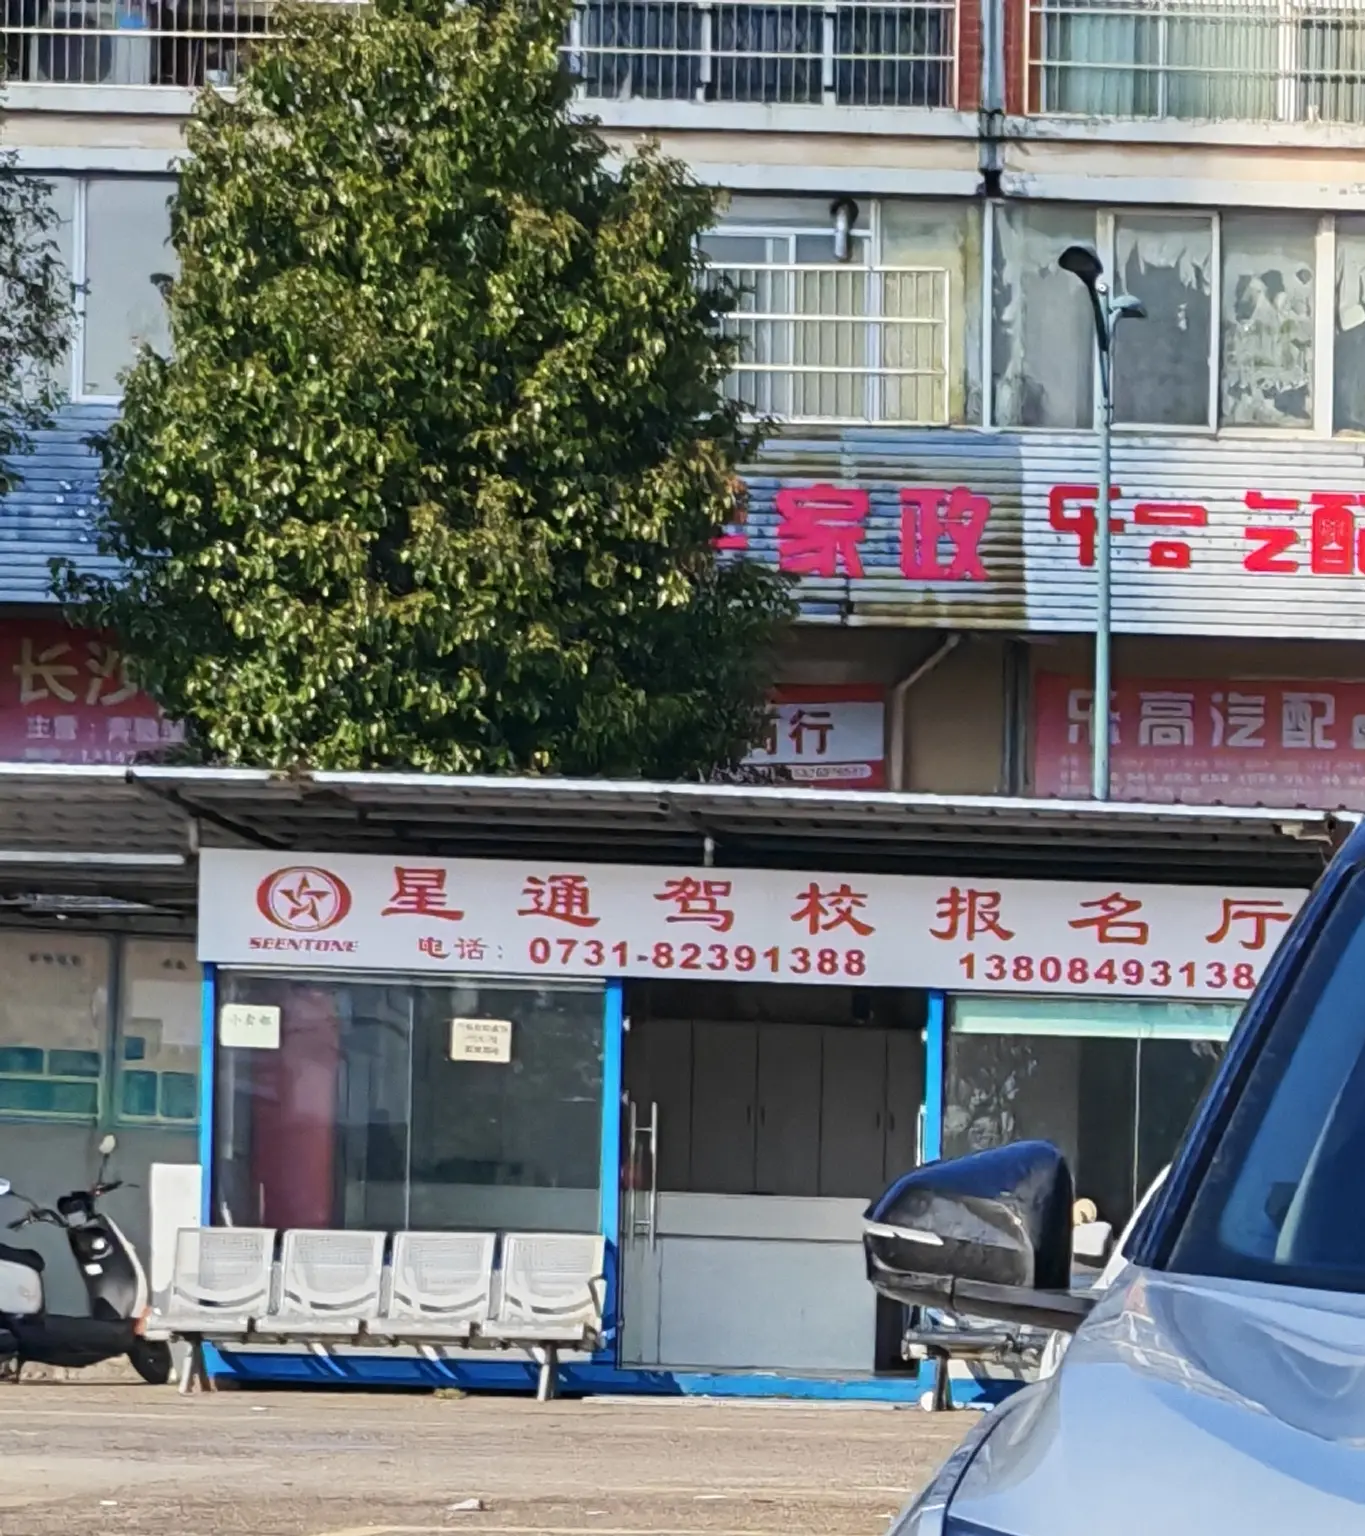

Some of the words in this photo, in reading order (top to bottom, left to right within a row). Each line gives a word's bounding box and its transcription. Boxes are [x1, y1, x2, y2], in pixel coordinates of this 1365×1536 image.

[712, 483, 990, 580] 家政
[1067, 689, 1337, 749] 乐高汽配
[381, 865, 1294, 951] 星通驾校报名厅
[529, 936, 867, 977] 0731-82391388
[959, 951, 1256, 991] 13808493138
